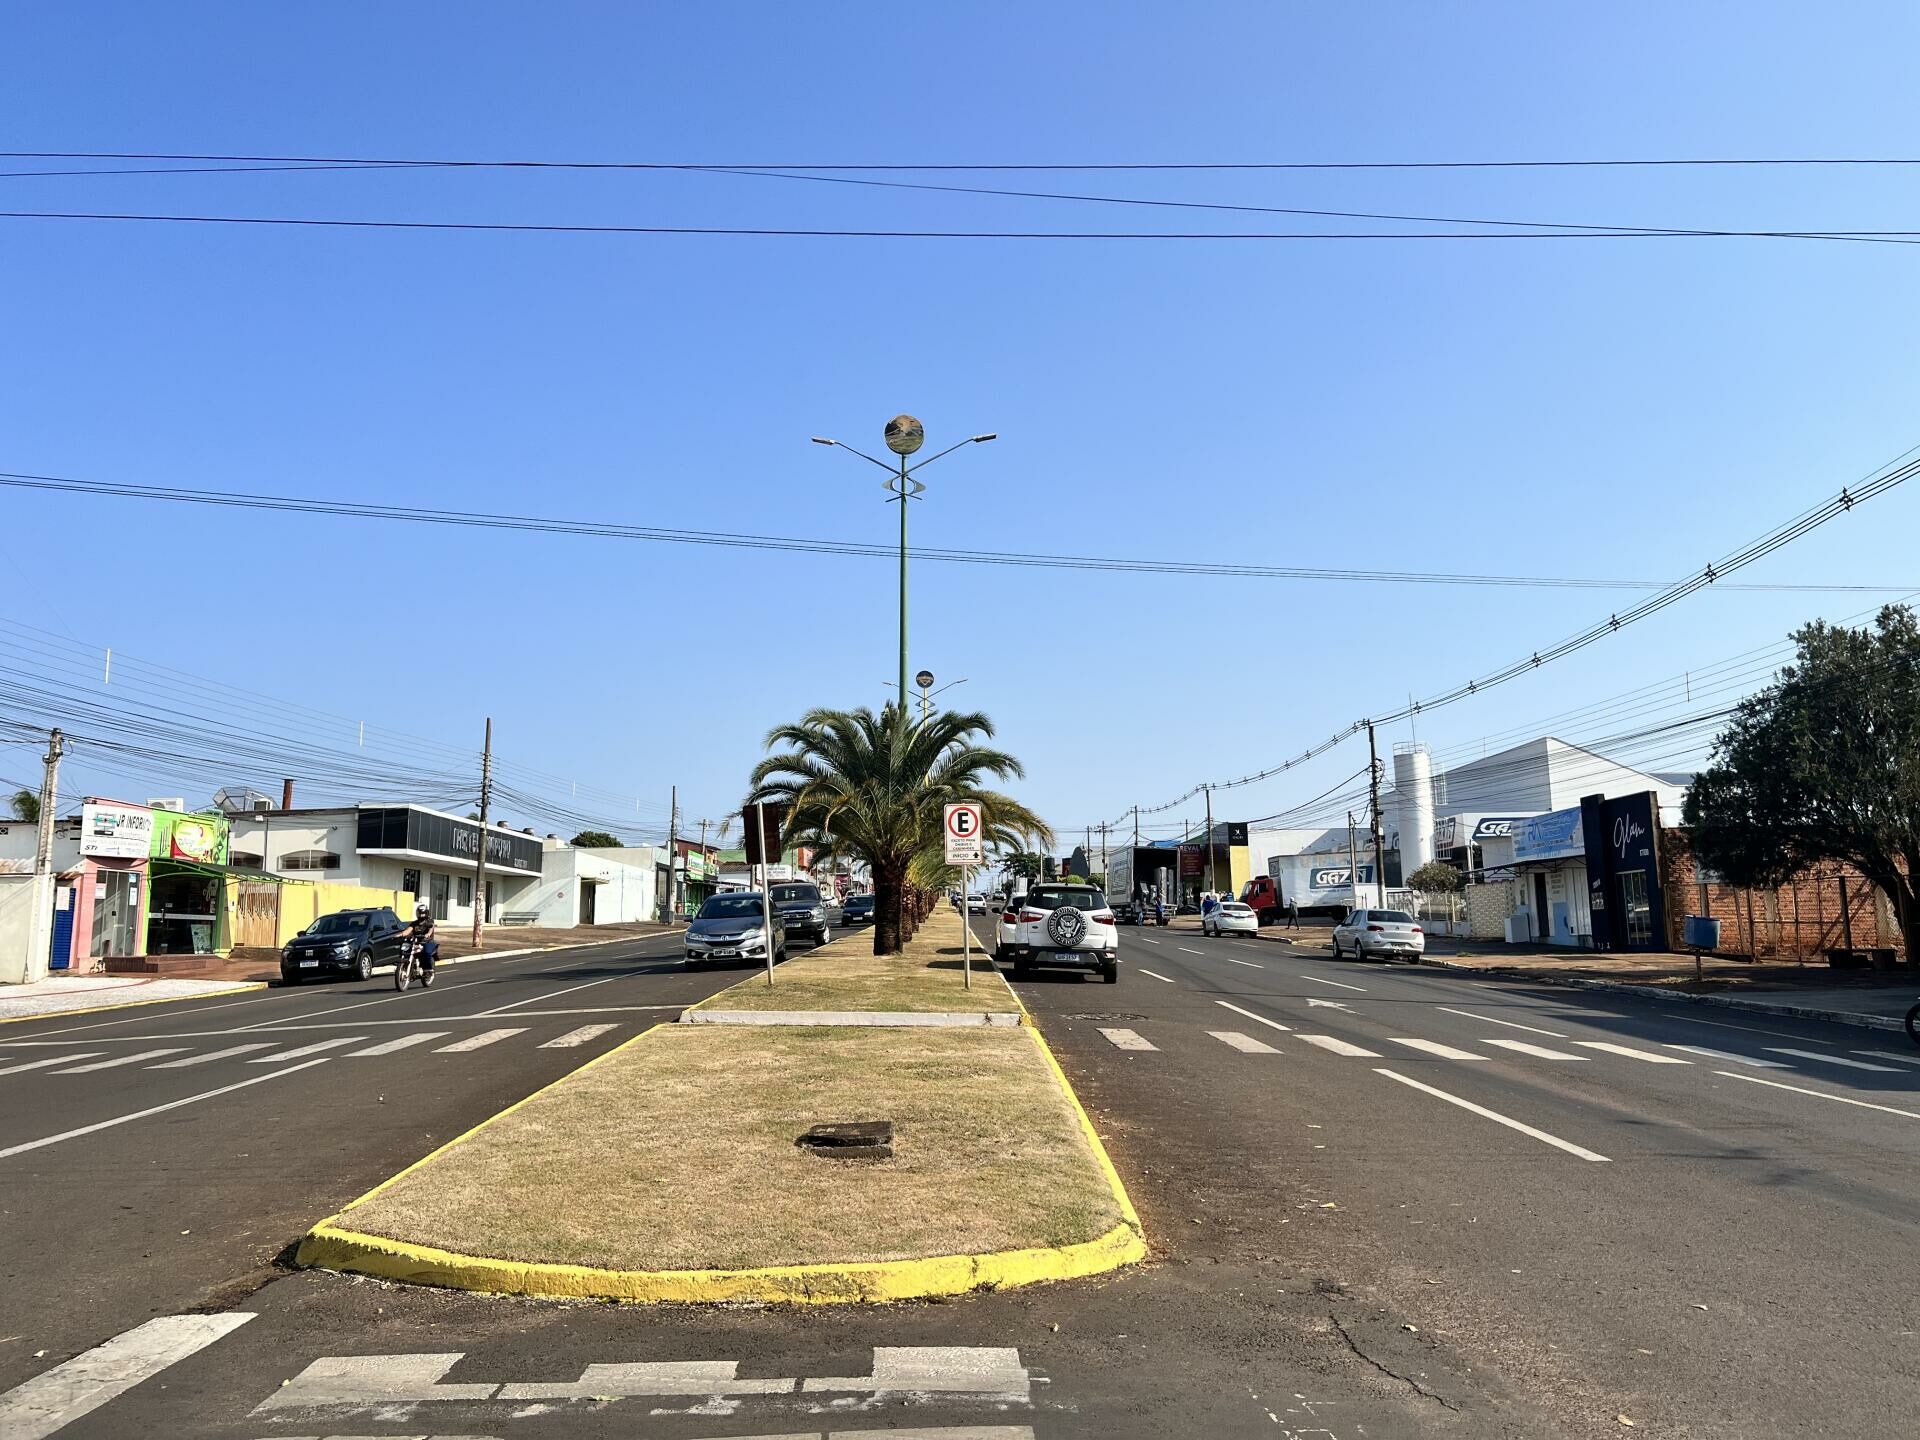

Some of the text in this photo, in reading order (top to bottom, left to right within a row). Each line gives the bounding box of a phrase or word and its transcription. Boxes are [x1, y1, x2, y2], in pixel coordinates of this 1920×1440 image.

[957, 812, 969, 833] E
[1480, 820, 1511, 836] GA
[1316, 869, 1367, 885] GAZN
